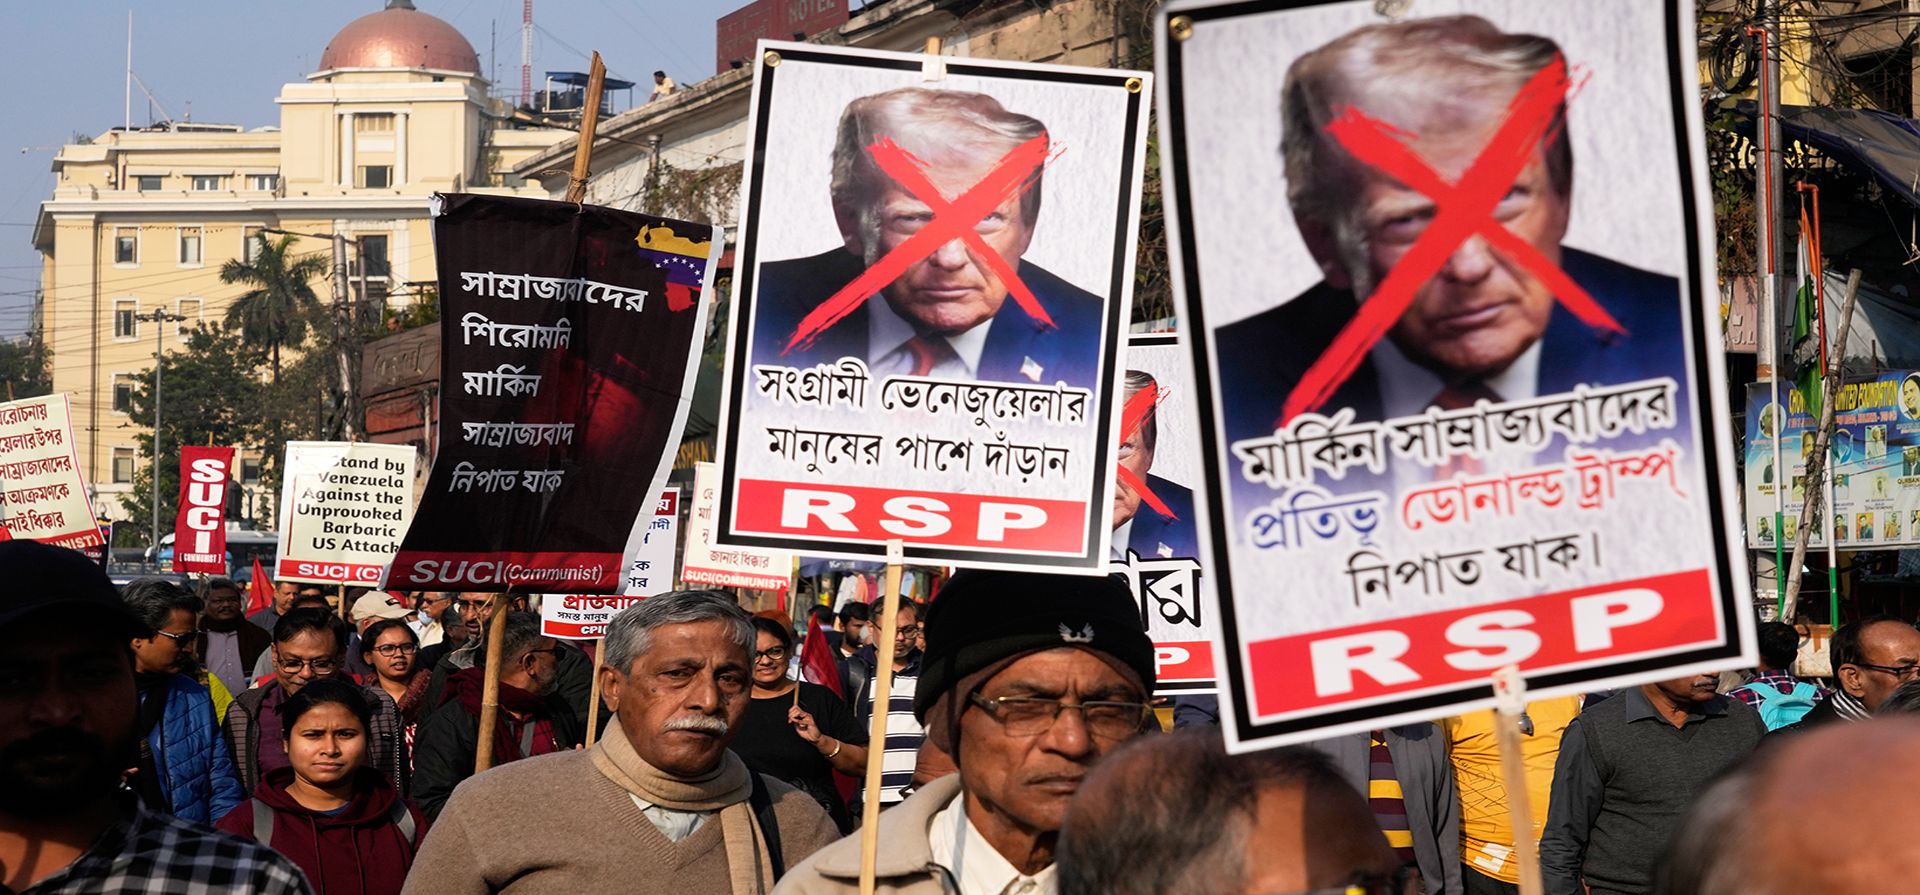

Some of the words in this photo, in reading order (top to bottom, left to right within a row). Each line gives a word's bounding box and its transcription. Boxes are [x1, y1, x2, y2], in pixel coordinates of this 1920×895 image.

[460, 271, 649, 312] সাম্রাজ্যবাদের
[460, 312, 572, 350] শিরোমনি
[462, 363, 542, 397] মার্কিন
[758, 361, 868, 408] সংগ্রামী
[882, 378, 1088, 426] ভেনেজুয়েলার
[1858, 379, 1898, 409] FOUNDATION
[462, 421, 575, 447] সাম্রাজ্যবাদ
[1243, 411, 1379, 481] মার্কিন
[1393, 384, 1670, 459] সাম্রাজ্যবাদের
[385, 459, 405, 475] by
[766, 425, 883, 474] মানুষের
[896, 433, 974, 472] পাশে
[983, 430, 1070, 483] দাঁড়ান
[319, 472, 404, 489] Venezuela
[448, 461, 519, 493] নিপাত
[522, 469, 565, 493] যাক
[187, 459, 226, 554] SUCI
[297, 503, 402, 521] Unprovoked
[302, 488, 370, 503] Against
[375, 492, 403, 505] the
[1253, 490, 1380, 550] প্রতিভূ
[1402, 469, 1565, 530] ডোনাল্ড
[312, 537, 336, 551] US
[323, 521, 396, 537] Barbaric
[298, 563, 349, 579] SUCI
[1344, 550, 1484, 607] নিপাত
